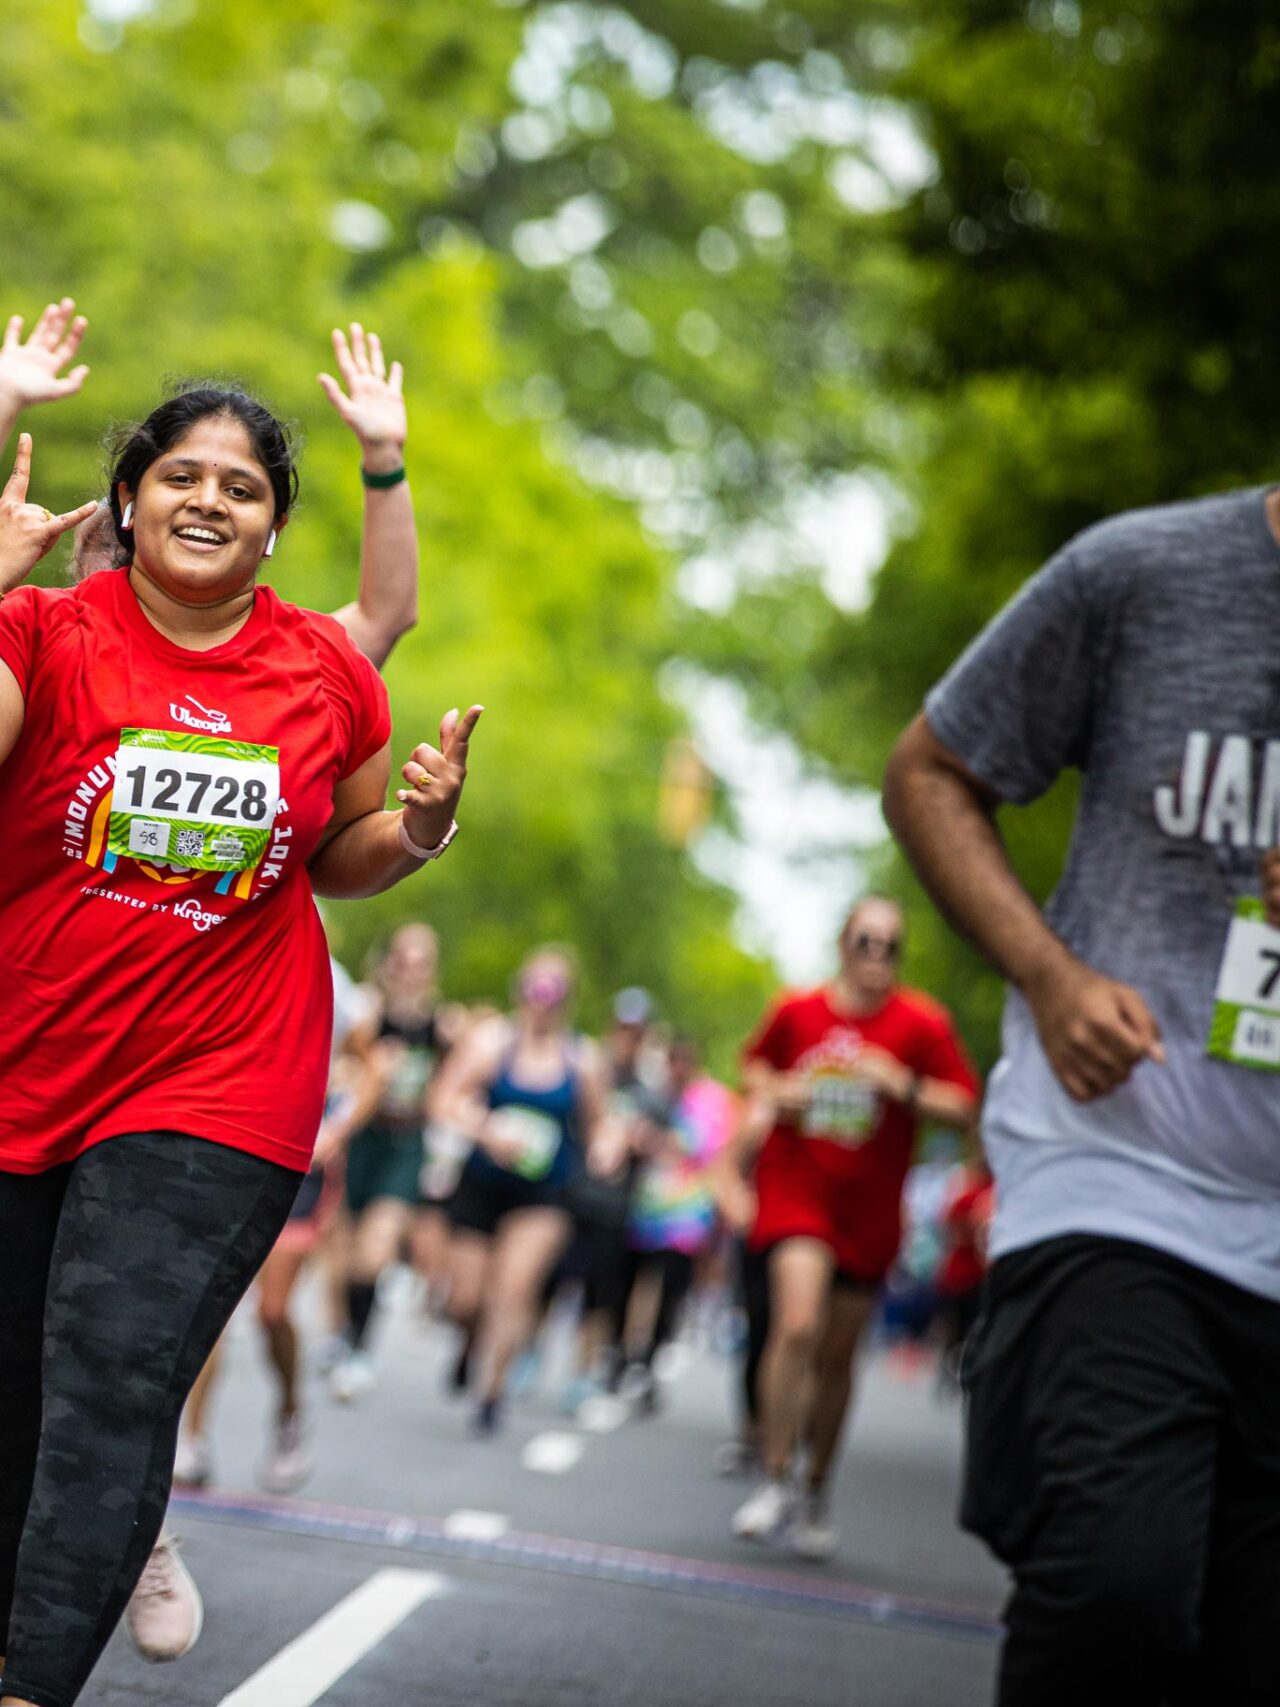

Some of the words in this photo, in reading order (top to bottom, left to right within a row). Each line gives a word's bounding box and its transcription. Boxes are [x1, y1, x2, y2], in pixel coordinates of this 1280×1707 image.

[126, 765, 268, 822] 12728
[152, 903, 168, 913] BY
[173, 899, 227, 932] Kroger
